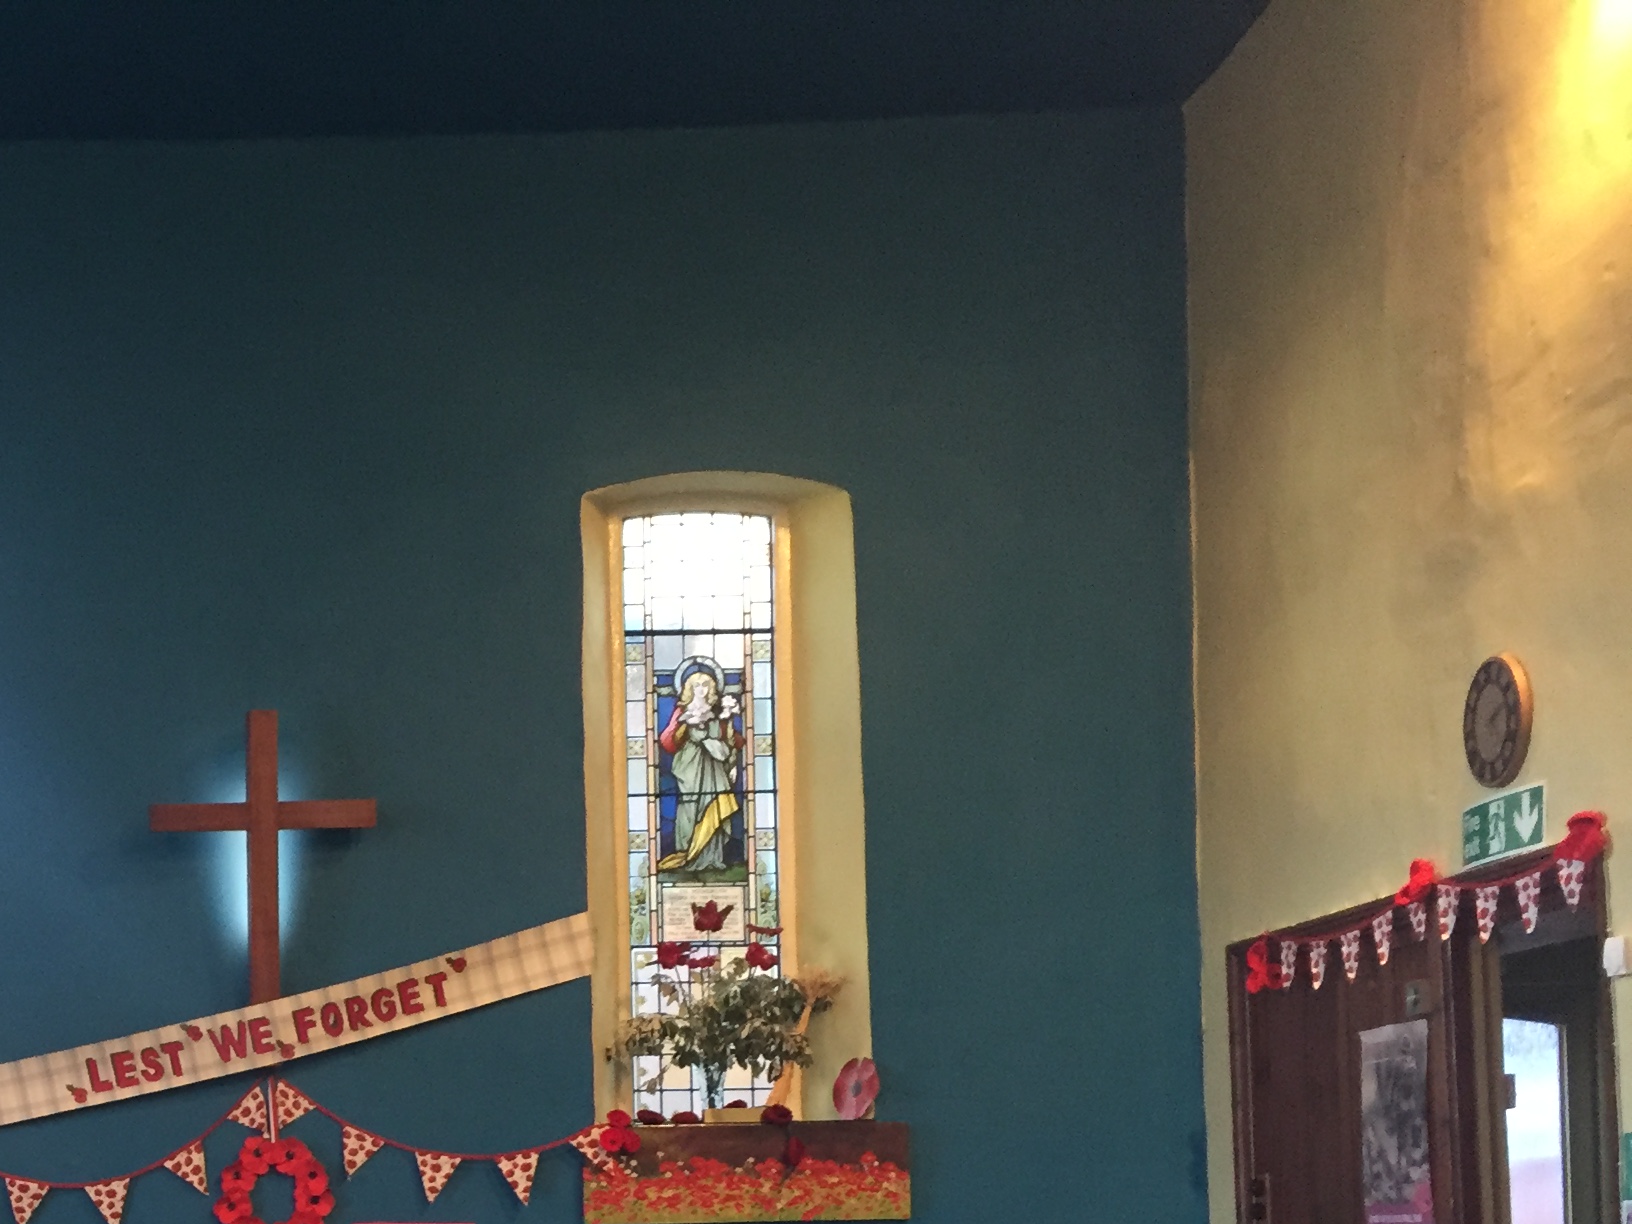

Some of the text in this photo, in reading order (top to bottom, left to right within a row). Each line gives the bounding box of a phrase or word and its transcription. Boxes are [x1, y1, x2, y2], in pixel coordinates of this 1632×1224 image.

[86, 972, 448, 1093] LEST WE FORGET
